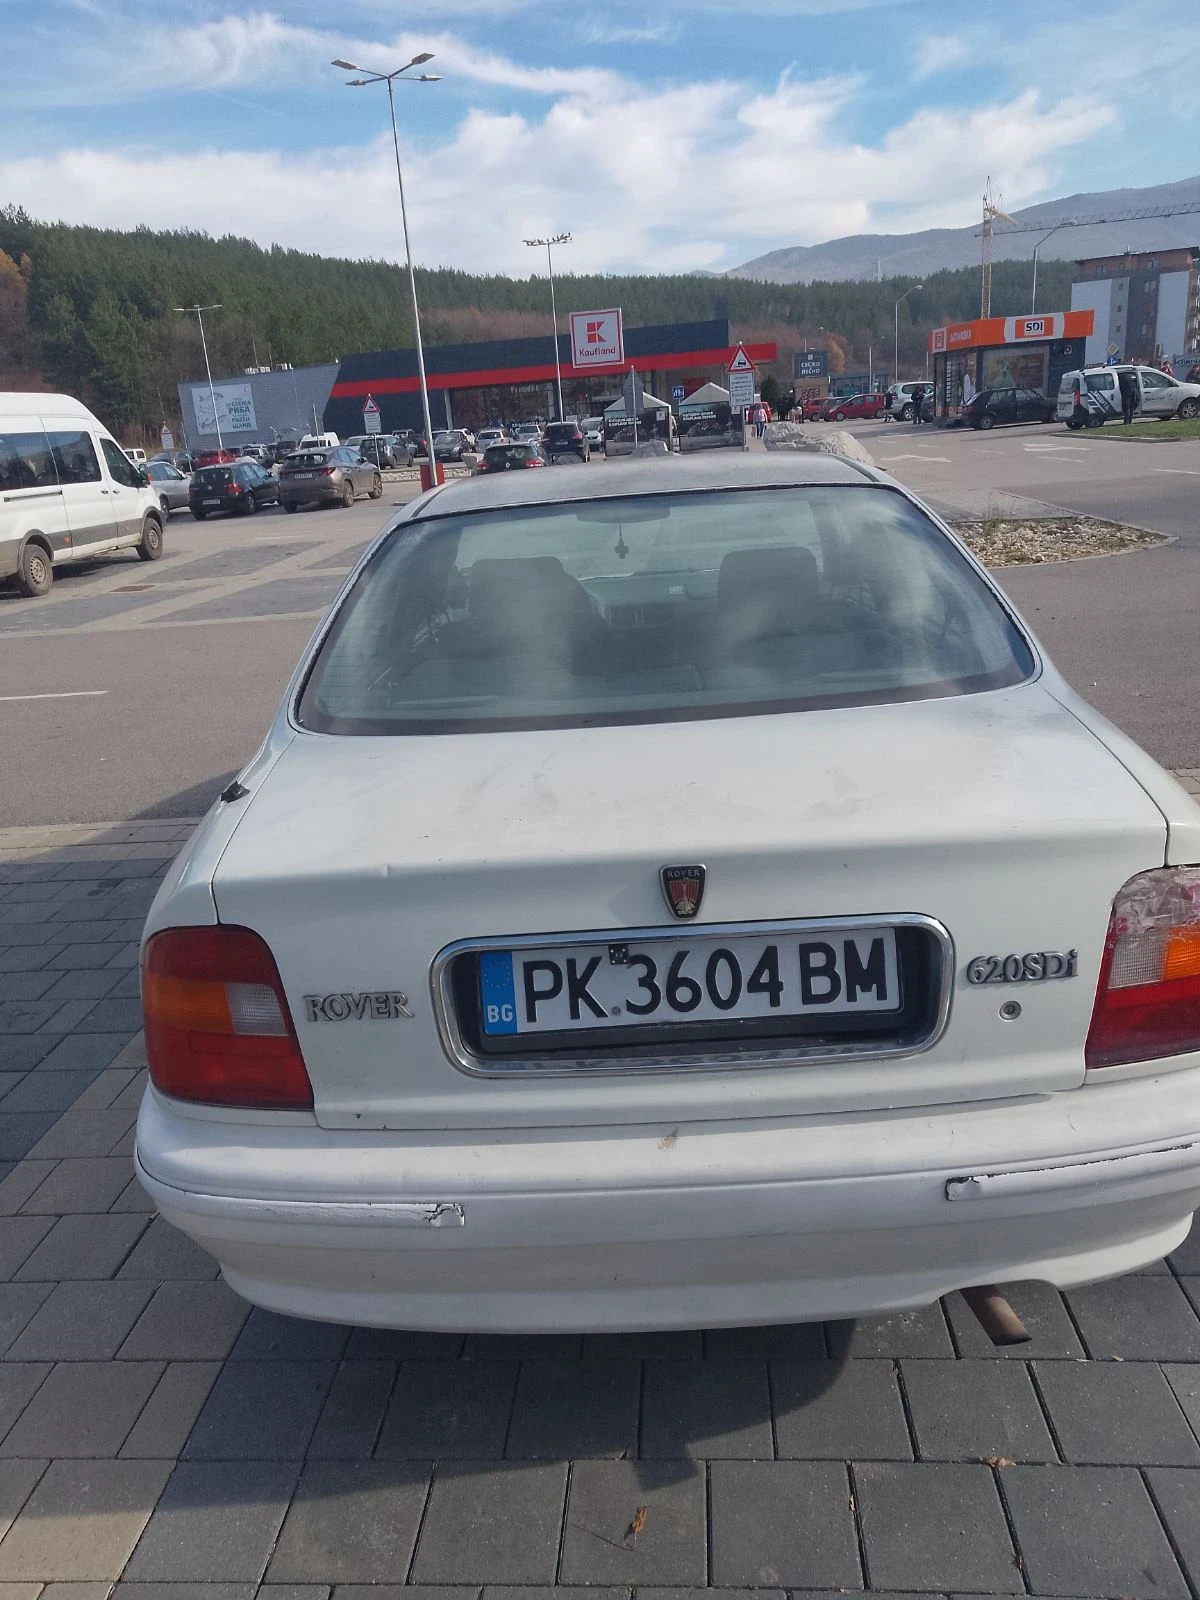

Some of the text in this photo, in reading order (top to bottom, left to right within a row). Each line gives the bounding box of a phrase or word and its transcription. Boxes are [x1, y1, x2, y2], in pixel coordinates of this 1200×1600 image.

[1026, 321, 1043, 332] SDI
[579, 346, 616, 357] Kaufland
[228, 406, 251, 415] РИБА
[667, 869, 700, 878] ROVER
[967, 948, 1079, 984] 620SDi
[522, 938, 888, 1023] PK 3604 BM
[303, 991, 415, 1022] ROVER
[487, 1003, 513, 1023] BG
